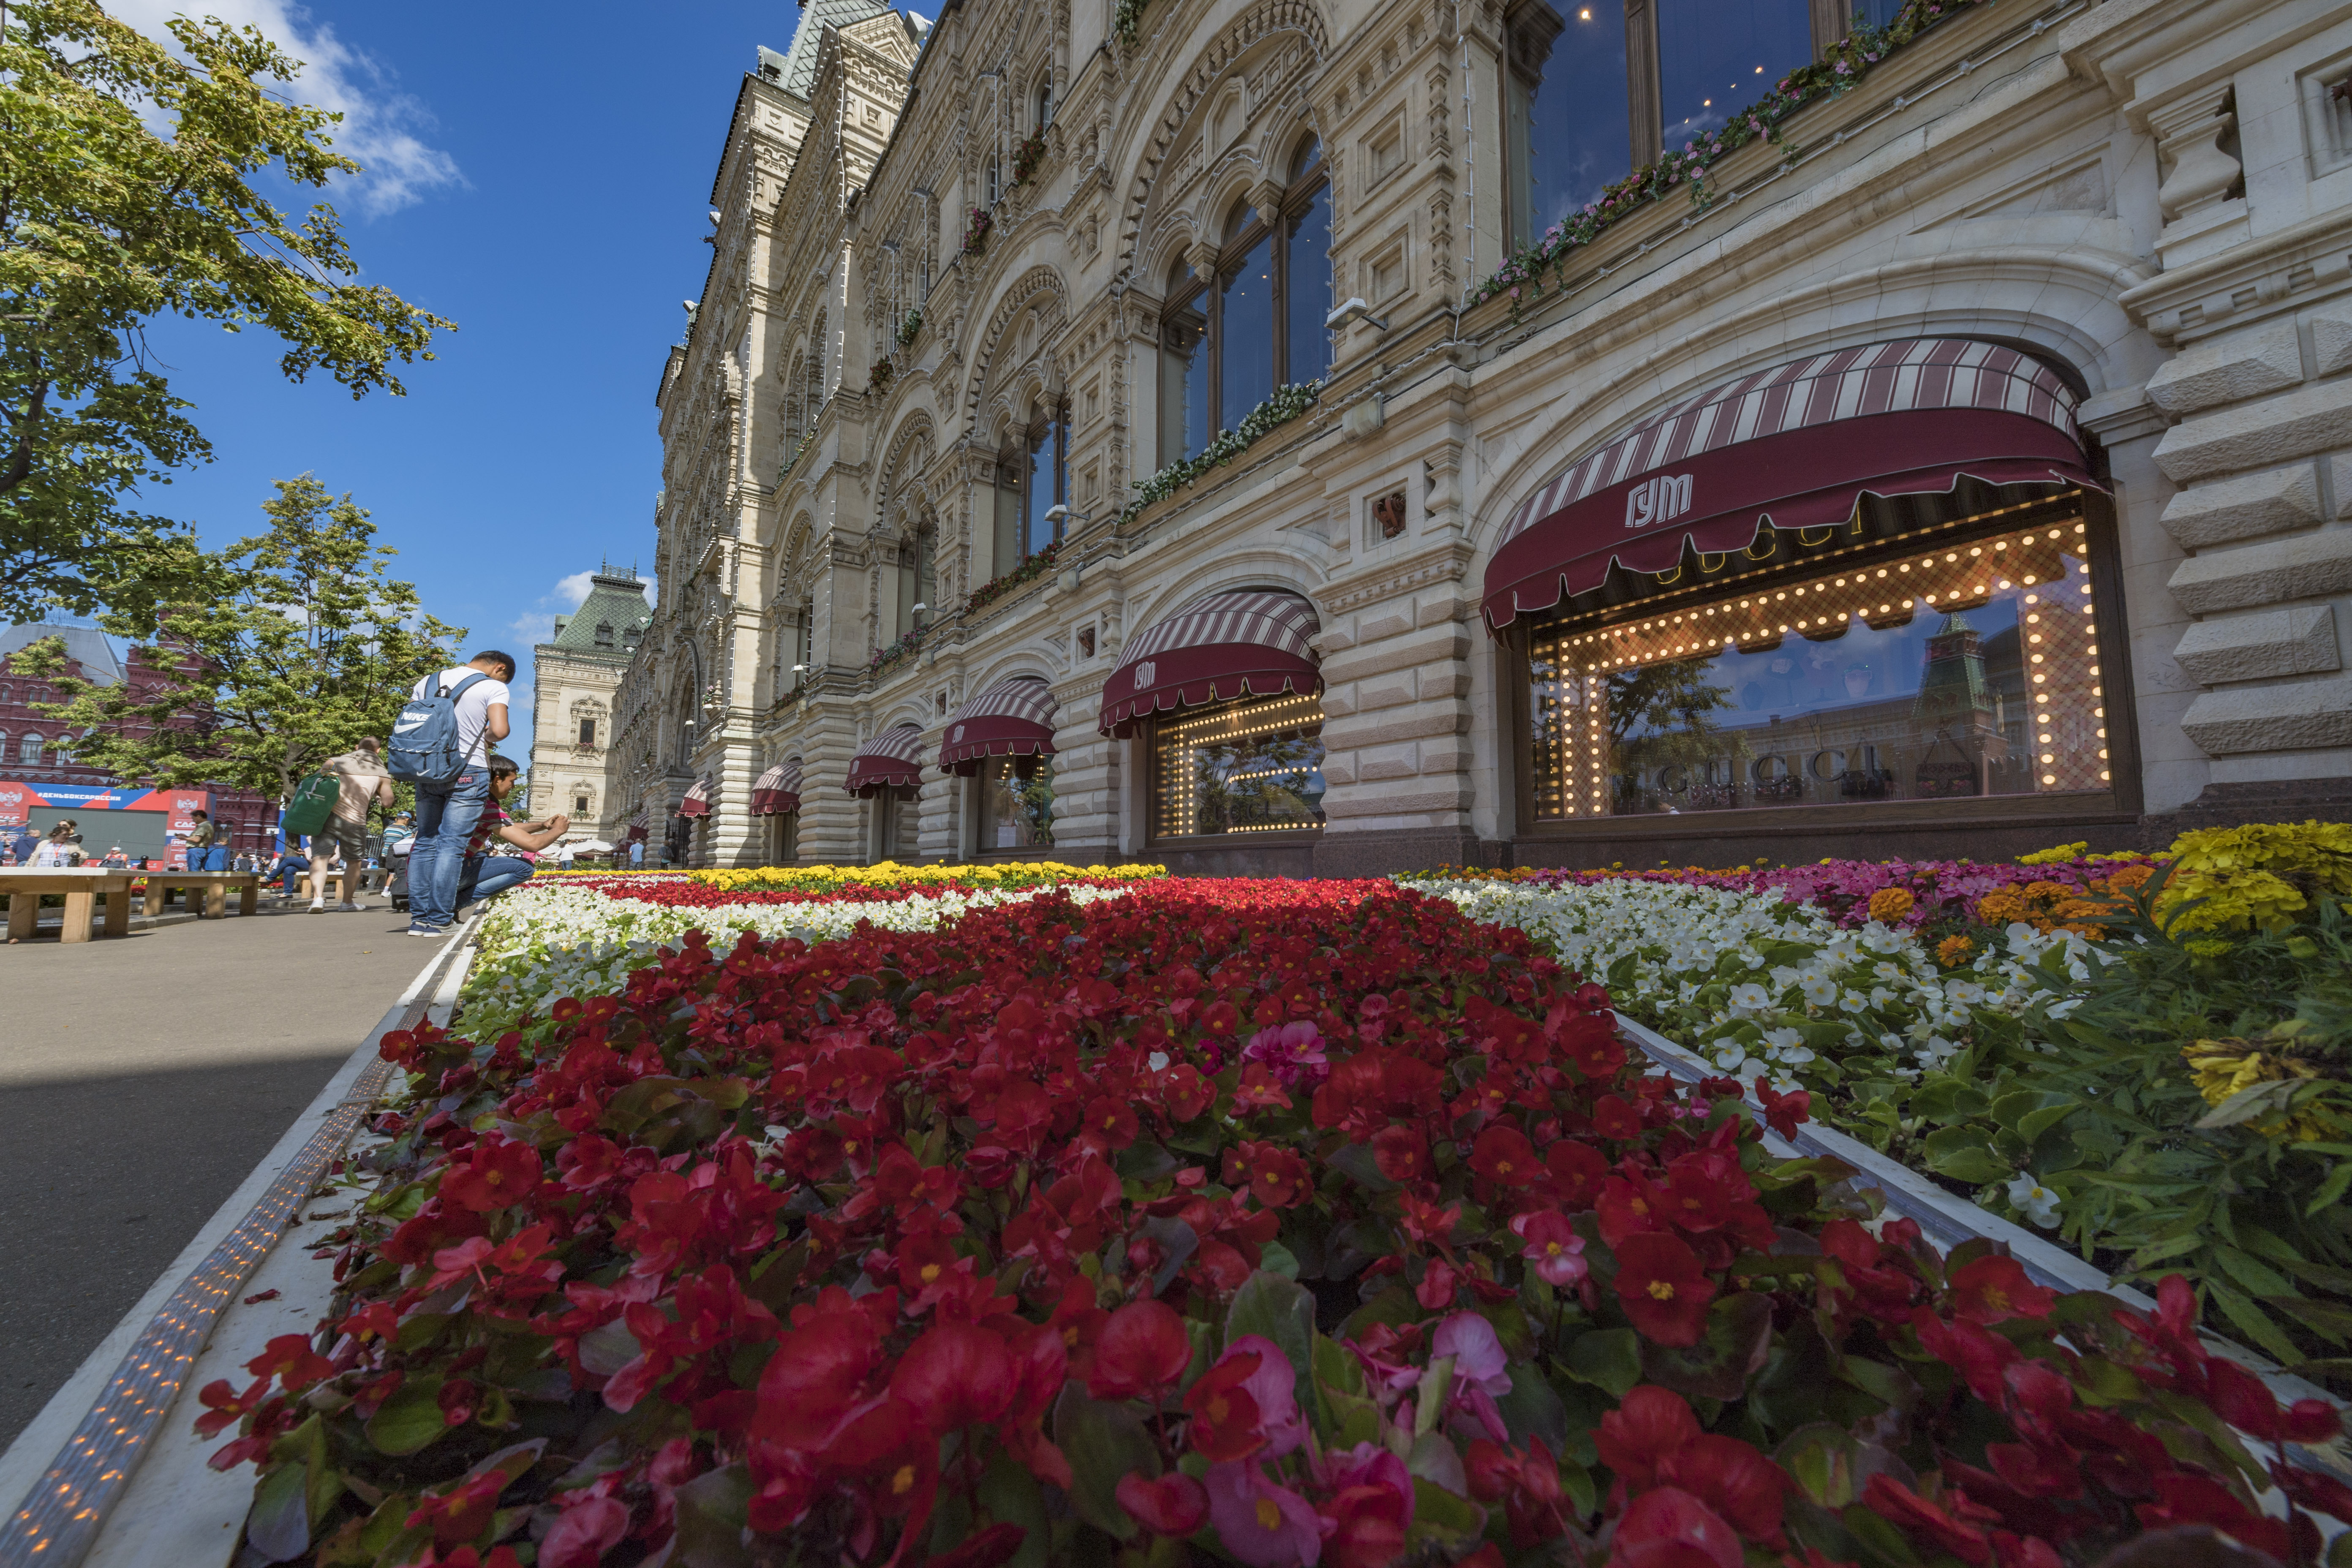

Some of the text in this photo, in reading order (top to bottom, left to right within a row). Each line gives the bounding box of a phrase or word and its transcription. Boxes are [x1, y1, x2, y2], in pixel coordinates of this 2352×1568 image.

[1625, 474, 1693, 528] ГУМ
[401, 711, 433, 721] NIKE
[1657, 746, 1876, 793] GUCCI
[37, 792, 121, 801] #ДЕНЬБОКСАРОССИИ
